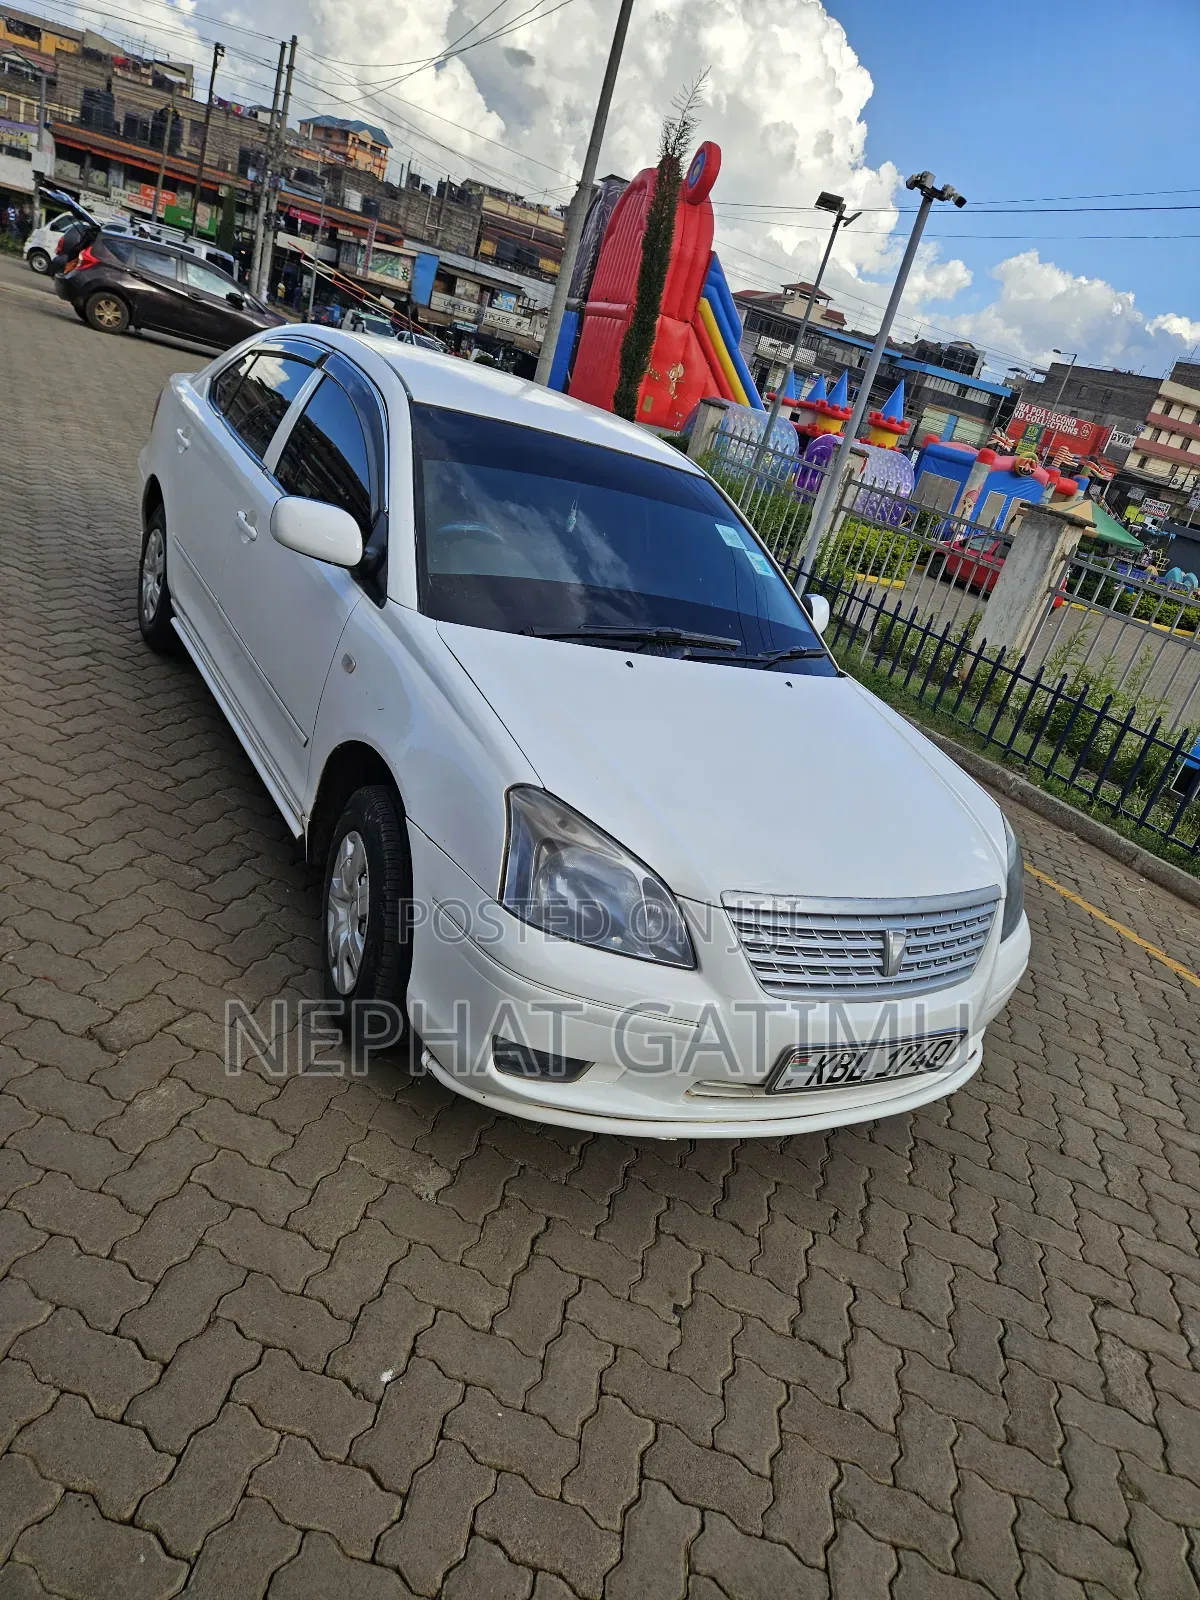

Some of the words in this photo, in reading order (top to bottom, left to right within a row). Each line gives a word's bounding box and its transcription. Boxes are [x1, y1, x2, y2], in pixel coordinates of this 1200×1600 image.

[443, 300, 467, 313] UNCLE
[489, 313, 510, 325] PLACE
[1025, 413, 1079, 435] COLLECTIONS
[1047, 411, 1077, 427] SECOND
[1111, 433, 1130, 445] GYM
[804, 1051, 868, 1086] KBL
